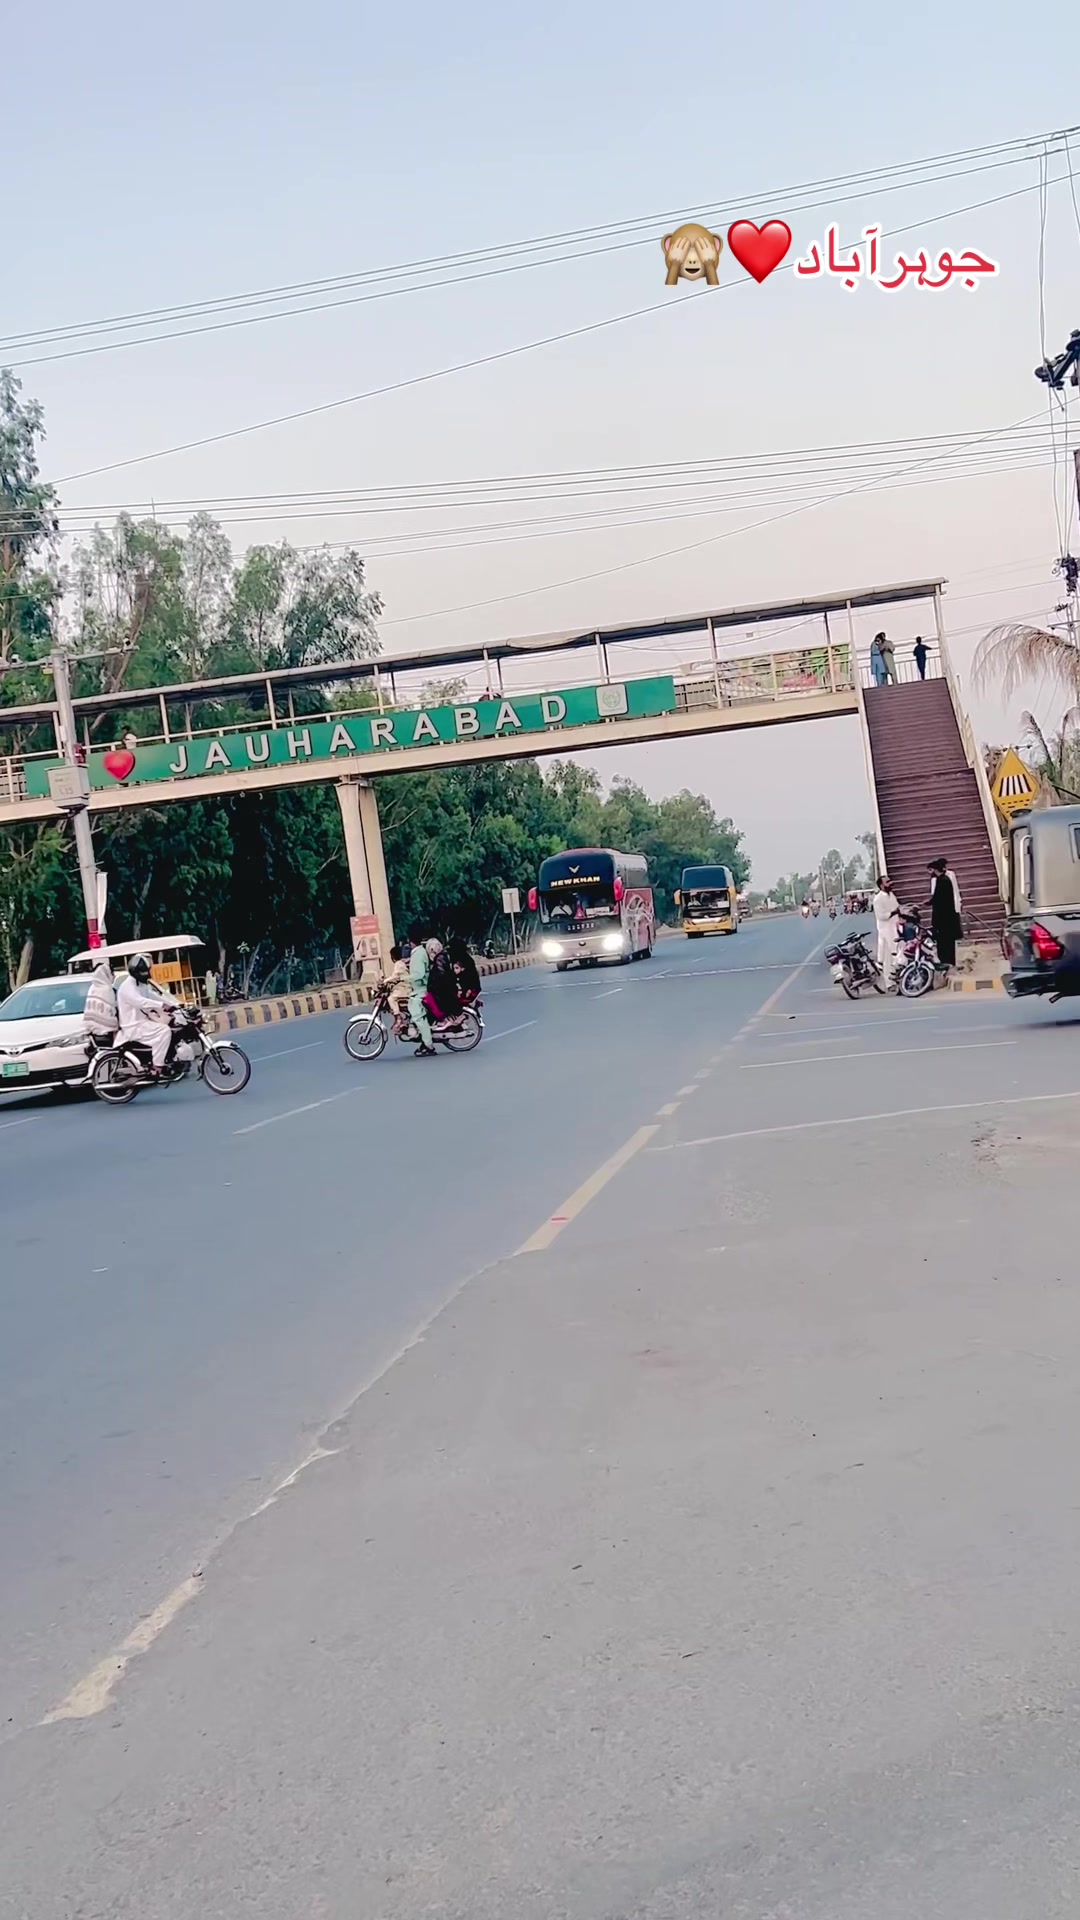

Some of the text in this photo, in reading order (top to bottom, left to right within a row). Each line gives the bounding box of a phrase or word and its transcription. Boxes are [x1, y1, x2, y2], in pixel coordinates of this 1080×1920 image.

[170, 695, 567, 773] JAUHARABAD
[550, 876, 601, 887] NEW KHAN
